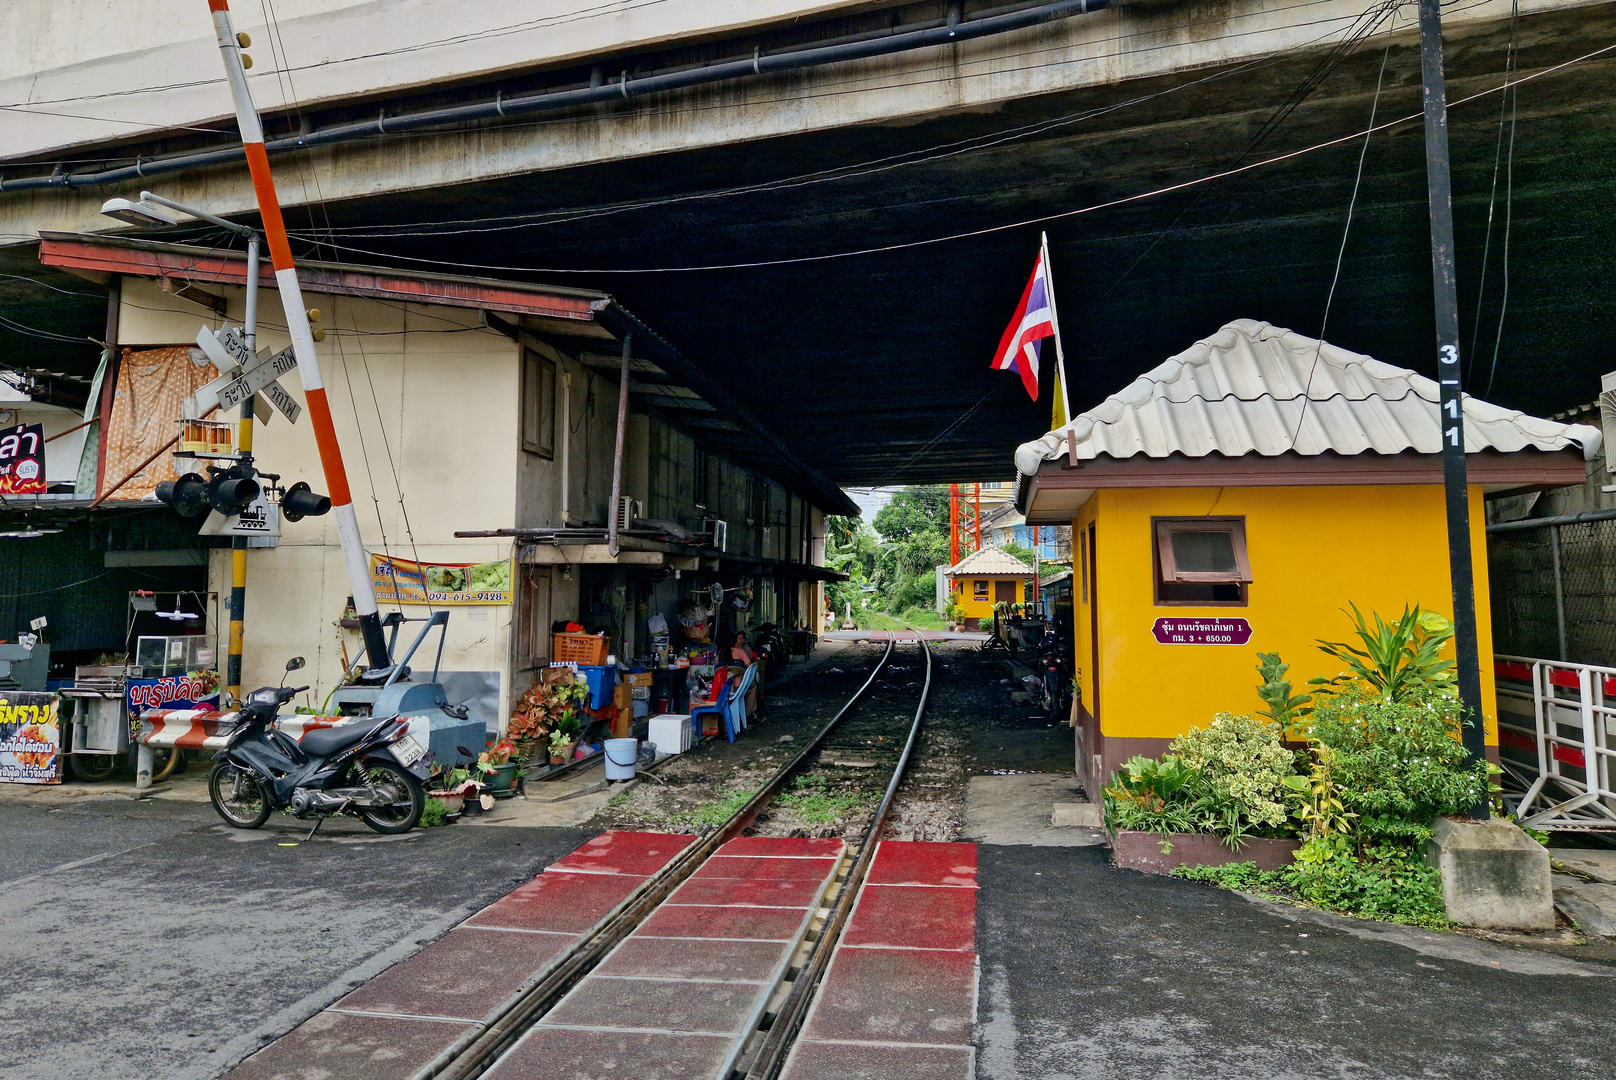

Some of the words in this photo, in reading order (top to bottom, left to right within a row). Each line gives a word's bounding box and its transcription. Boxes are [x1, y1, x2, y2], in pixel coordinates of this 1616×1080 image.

[224, 333, 250, 366] ระวัง
[271, 386, 297, 418] รถไฟ
[224, 376, 252, 406] ระวัง
[272, 348, 297, 375] รถไฟ
[428, 592, 502, 601] 094-615-9428
[1162, 620, 1174, 635] ซุ้ม
[1238, 624, 1243, 632] 1
